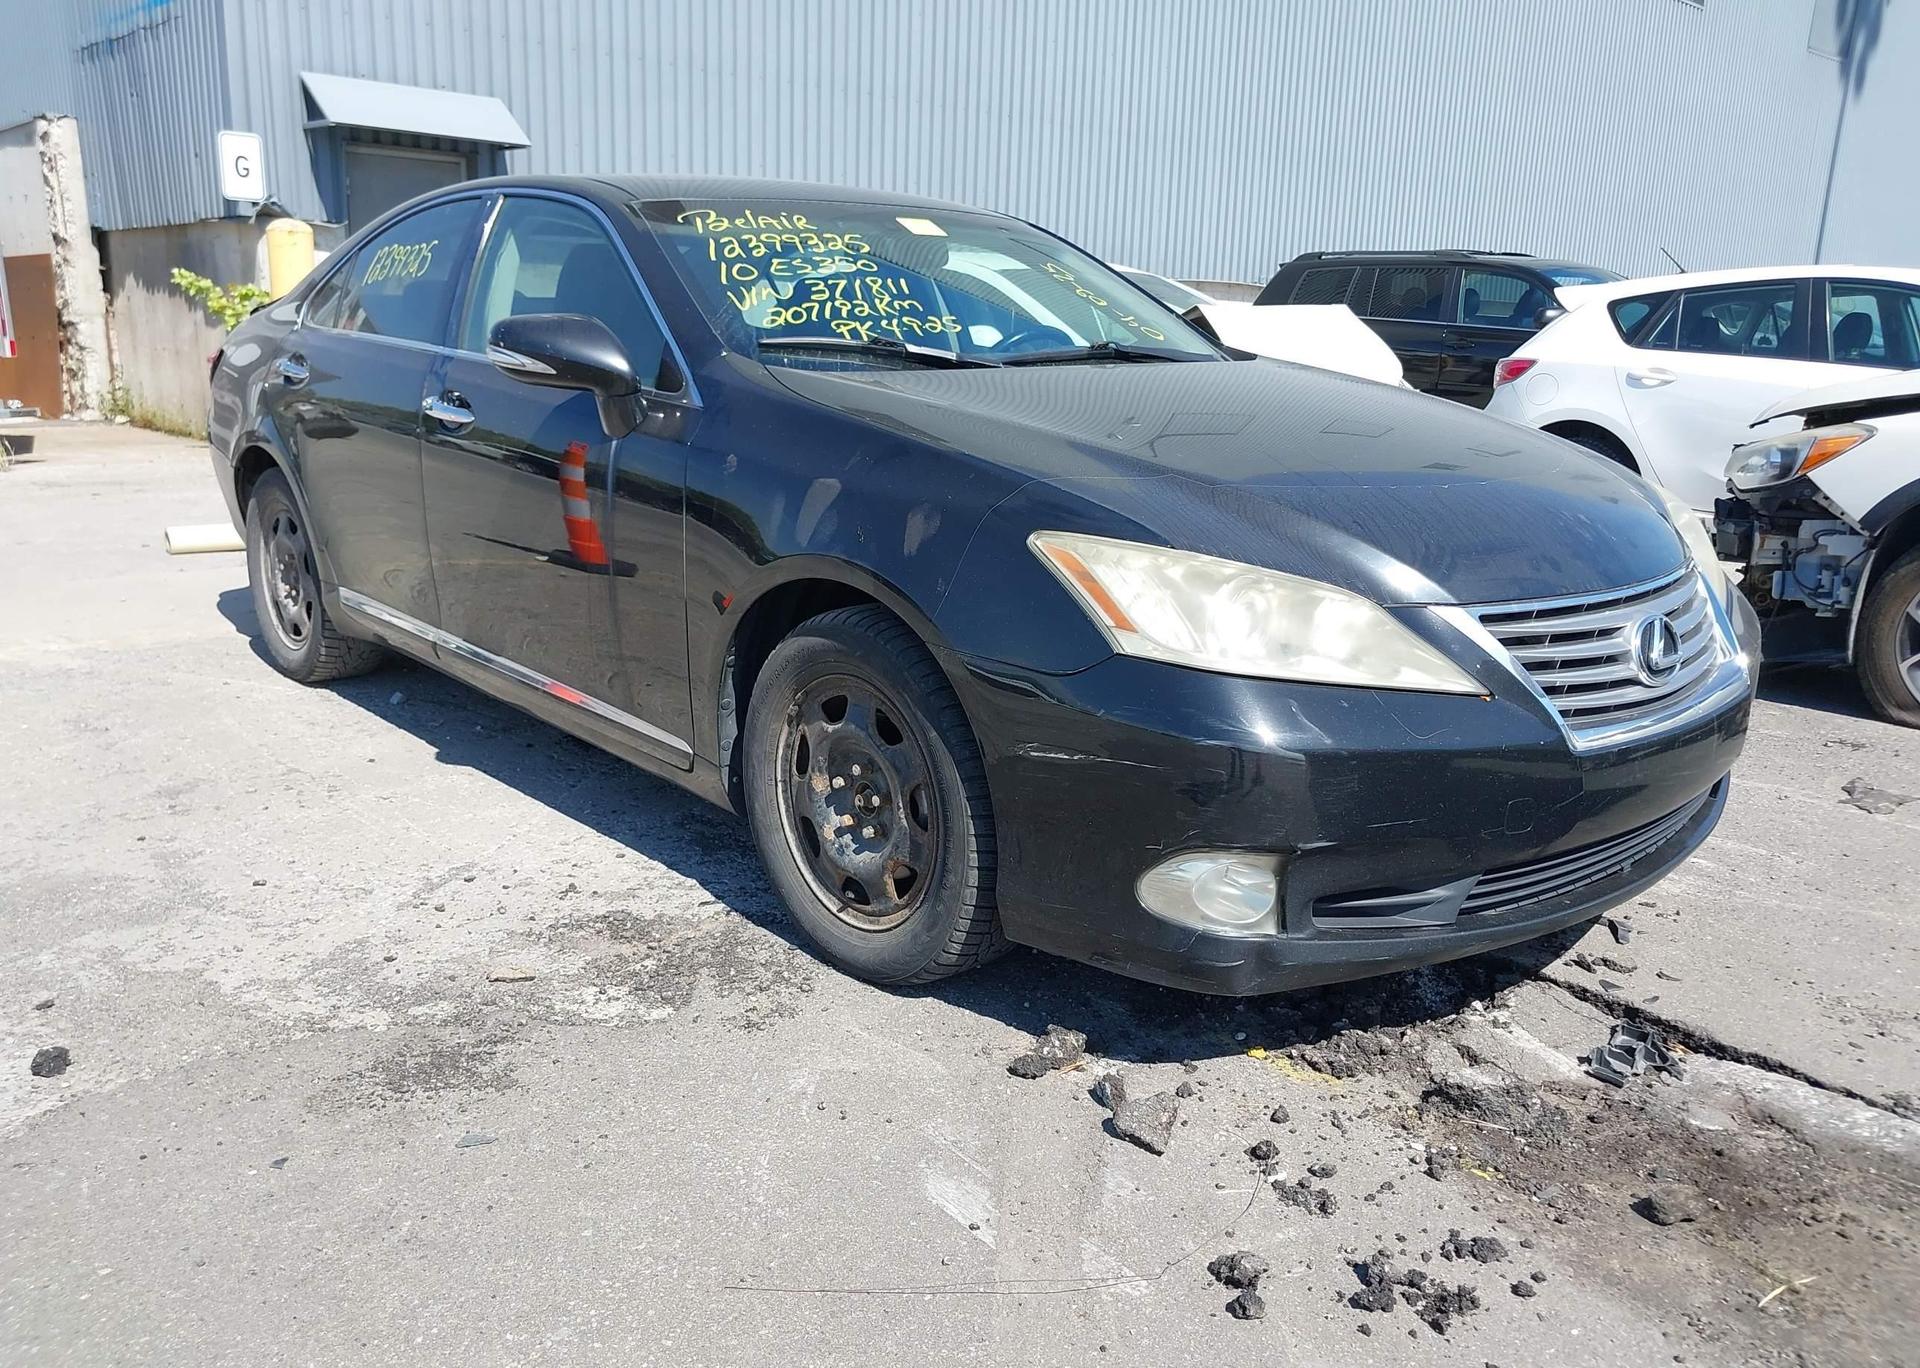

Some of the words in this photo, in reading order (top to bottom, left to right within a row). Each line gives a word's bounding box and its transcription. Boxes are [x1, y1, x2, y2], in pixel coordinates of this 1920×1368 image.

[235, 155, 250, 178] G
[709, 234, 870, 261] 12399325
[720, 261, 758, 285] 10
[770, 256, 878, 275] ES350
[805, 276, 910, 301] 371811
